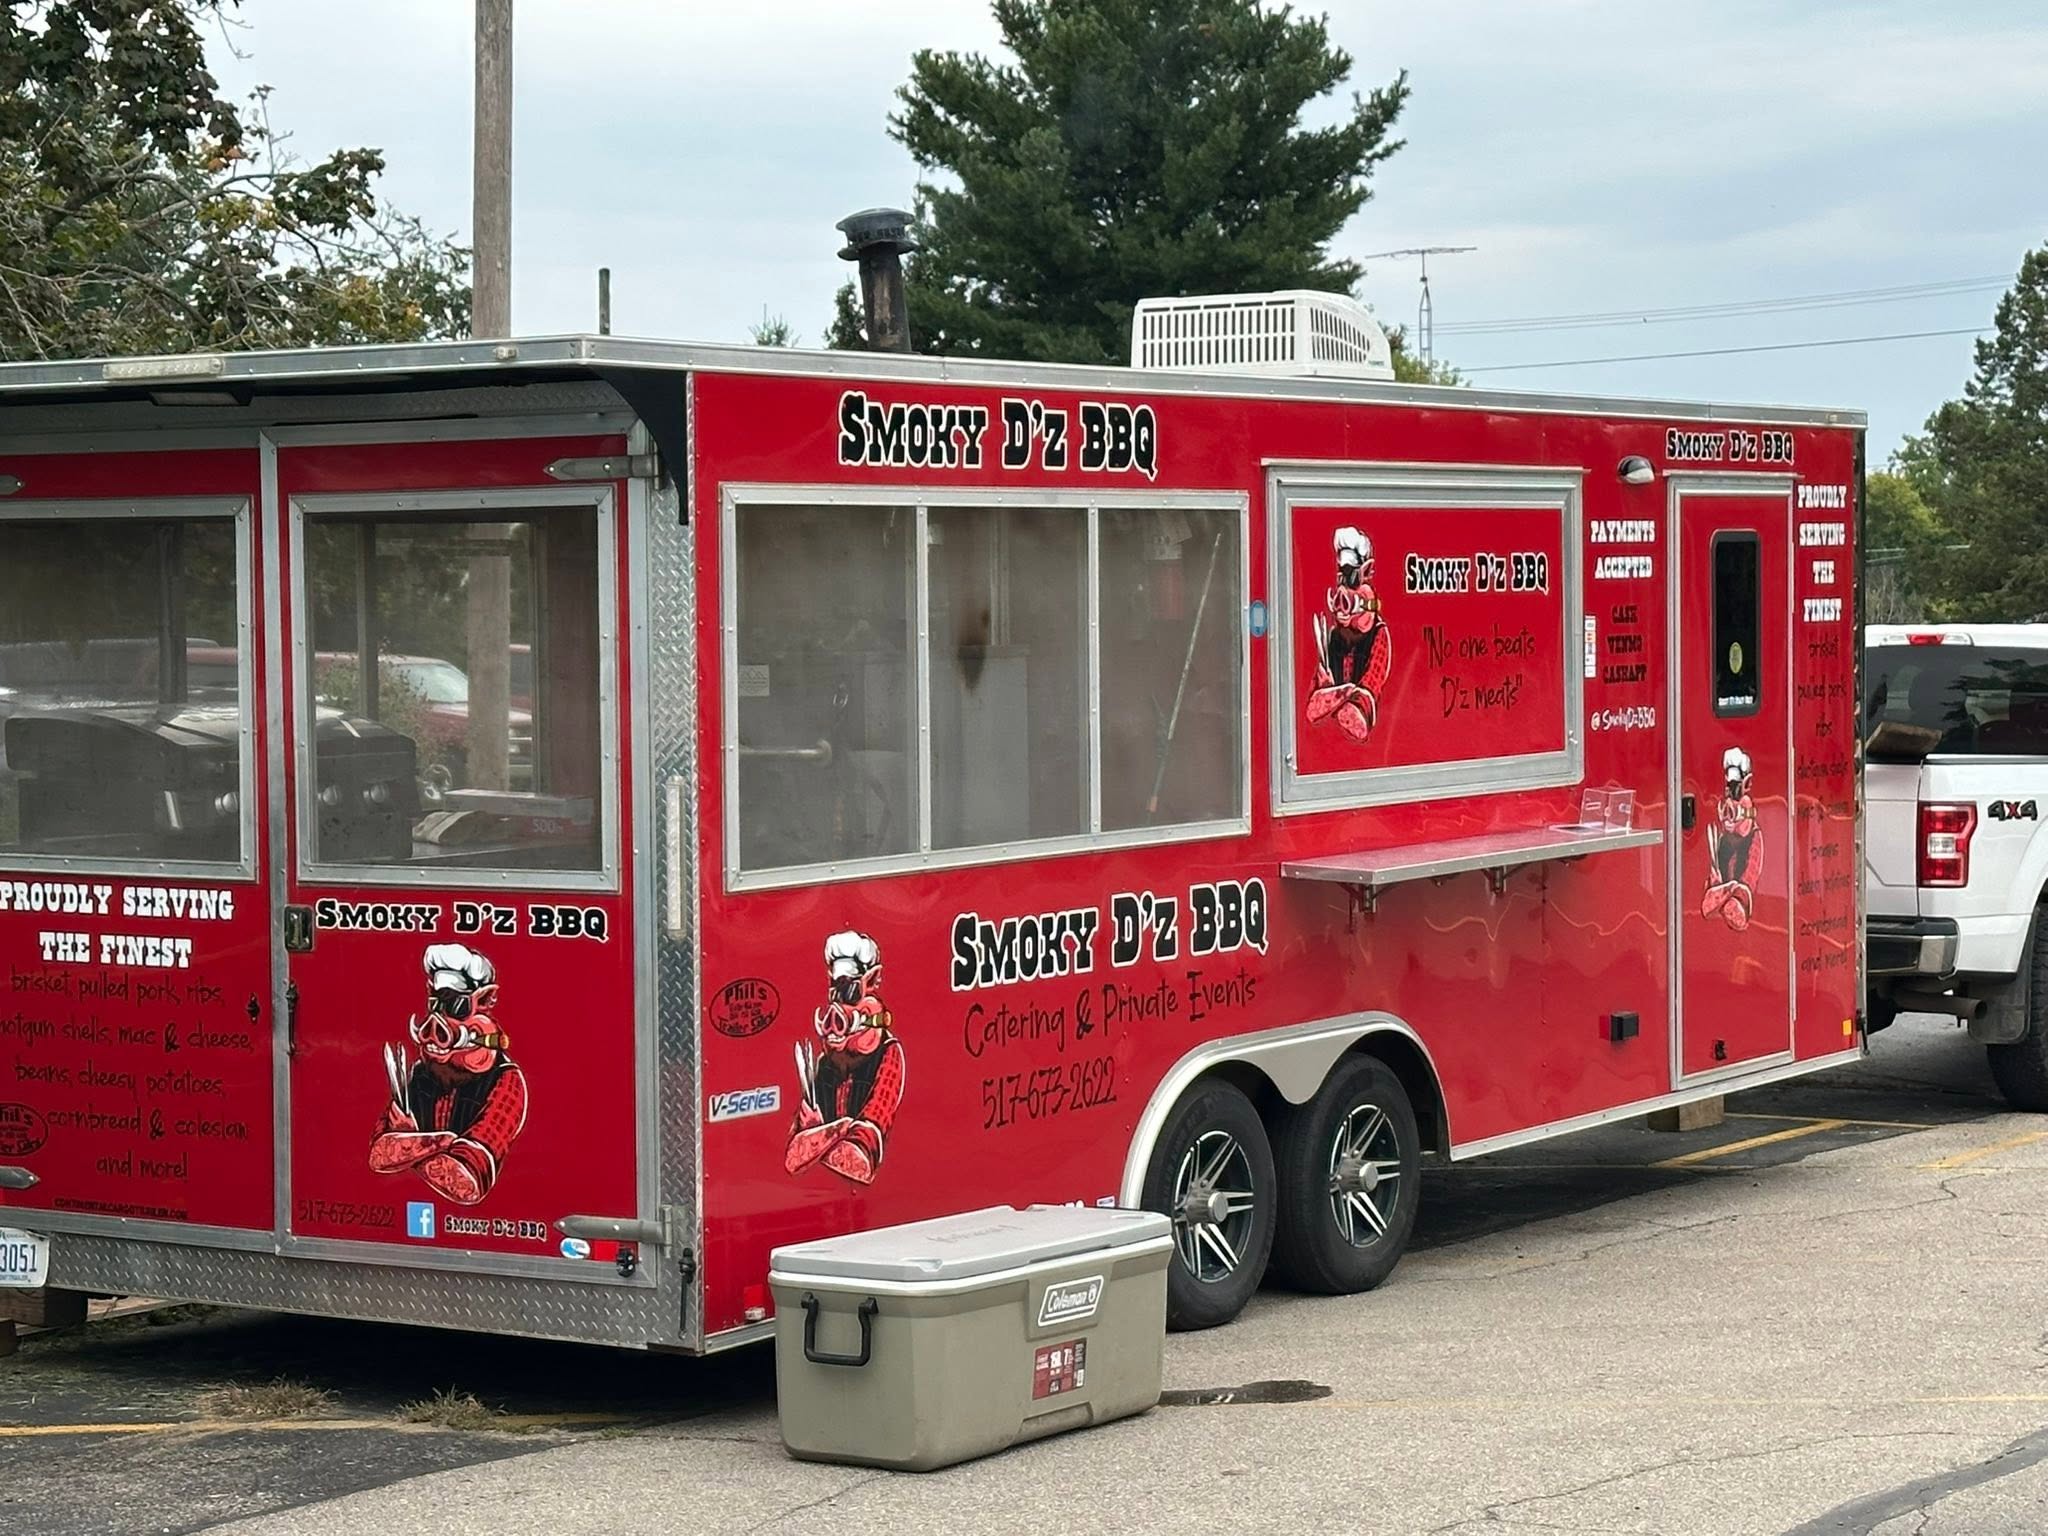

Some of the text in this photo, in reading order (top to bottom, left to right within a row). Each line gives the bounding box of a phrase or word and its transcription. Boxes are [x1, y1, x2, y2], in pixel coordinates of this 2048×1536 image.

[839, 391, 989, 469] SMOKY
[1079, 401, 1158, 481] BBQ
[1762, 430, 1795, 465] BBQ
[1798, 485, 1847, 508] PROUDLY
[1590, 520, 1655, 543] PAYMENTS
[1799, 523, 1845, 546] SERVING
[1510, 552, 1549, 595] BBQ
[1594, 556, 1653, 579] ACCEPTED
[1812, 561, 1834, 584] THE
[1459, 636, 1488, 660] one
[1494, 623, 1535, 660] beats
[0, 881, 235, 920] PROUDLY SERVING
[315, 898, 440, 933] SMOKY
[529, 904, 610, 944] BBQ
[951, 907, 1099, 992] SMOKY
[1189, 877, 1269, 957] BBQ
[39, 931, 192, 968] THE FINEST
[79, 971, 129, 1002] pulled
[964, 967, 1256, 1058] Catering & Private Events
[118, 1026, 156, 1045] mac
[164, 1022, 180, 1053] &
[982, 1055, 1117, 1130] 517-673-2622
[47, 1103, 142, 1135] cornbread
[149, 1107, 165, 1140] &
[96, 1149, 133, 1177] and
[519, 1219, 547, 1242] BBQ
[1047, 1288, 1087, 1313] Coleman
